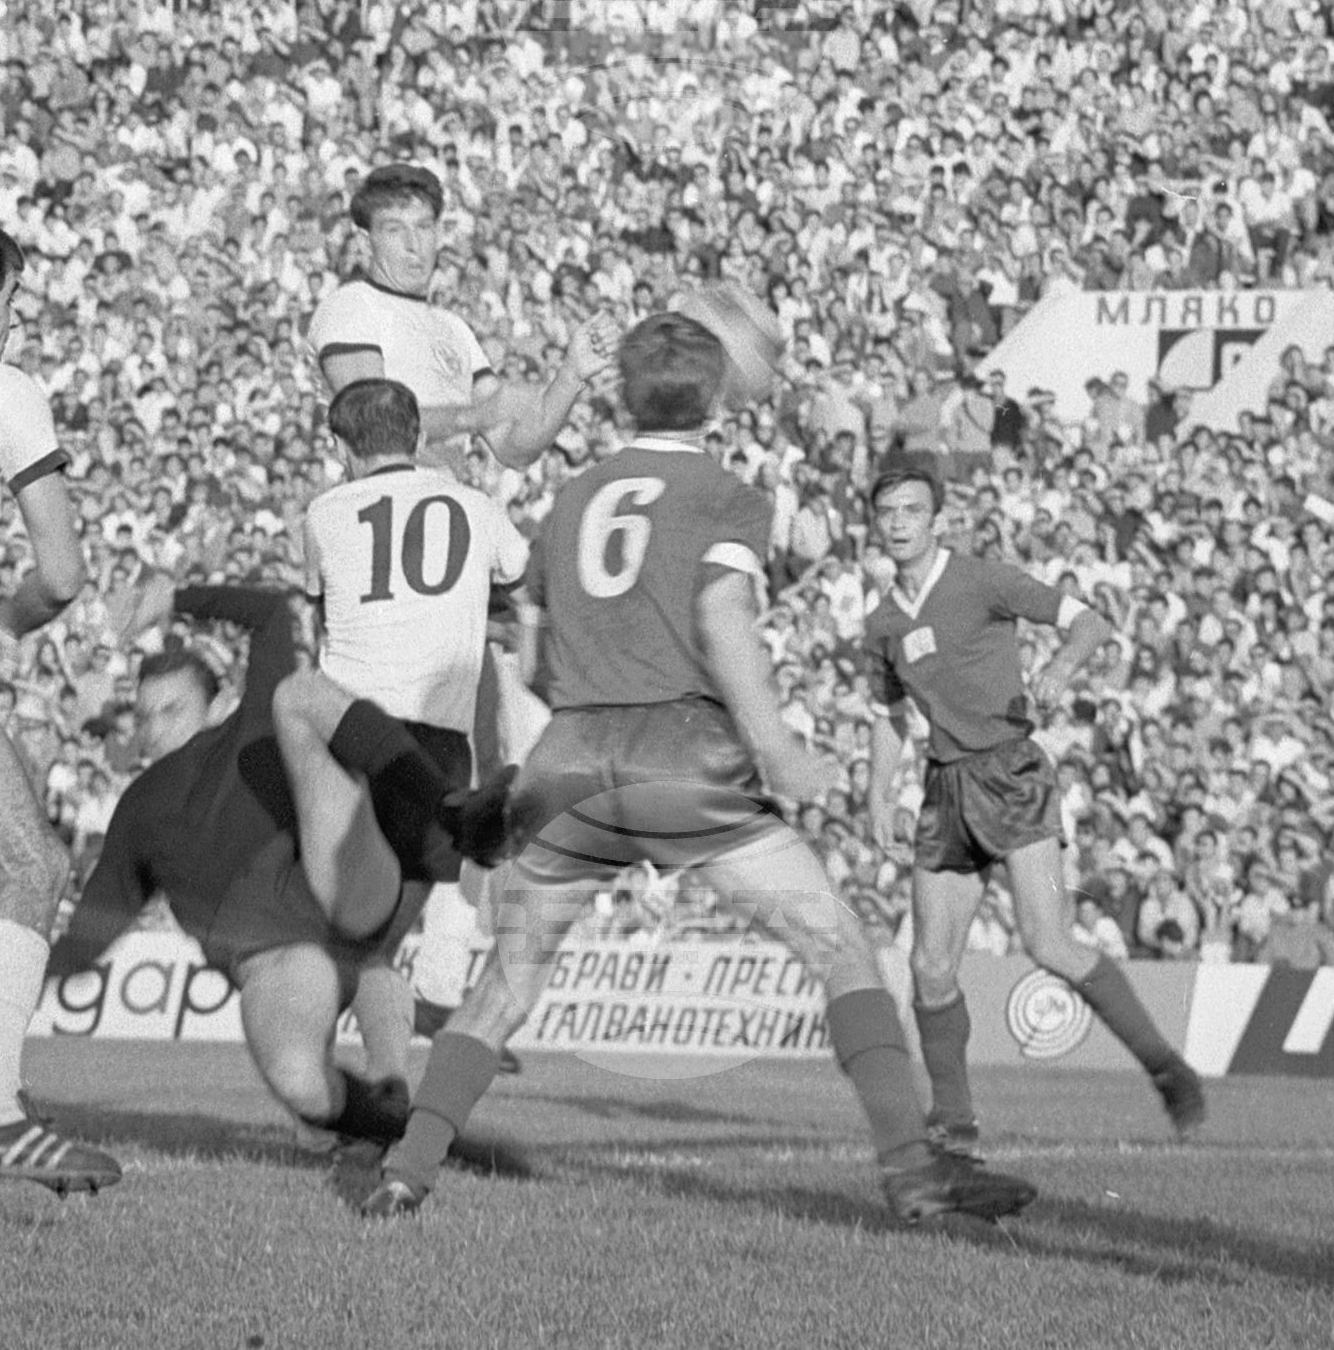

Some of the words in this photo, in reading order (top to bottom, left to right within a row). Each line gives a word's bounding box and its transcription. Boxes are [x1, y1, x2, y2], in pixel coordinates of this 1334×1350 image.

[1096, 295, 1276, 326] МЛЯКО
[358, 494, 471, 604] 10
[577, 477, 666, 598] 6
[548, 950, 672, 991] БРАВИ
[535, 1001, 831, 1050] ГАЛВАНОТЕХНИК
